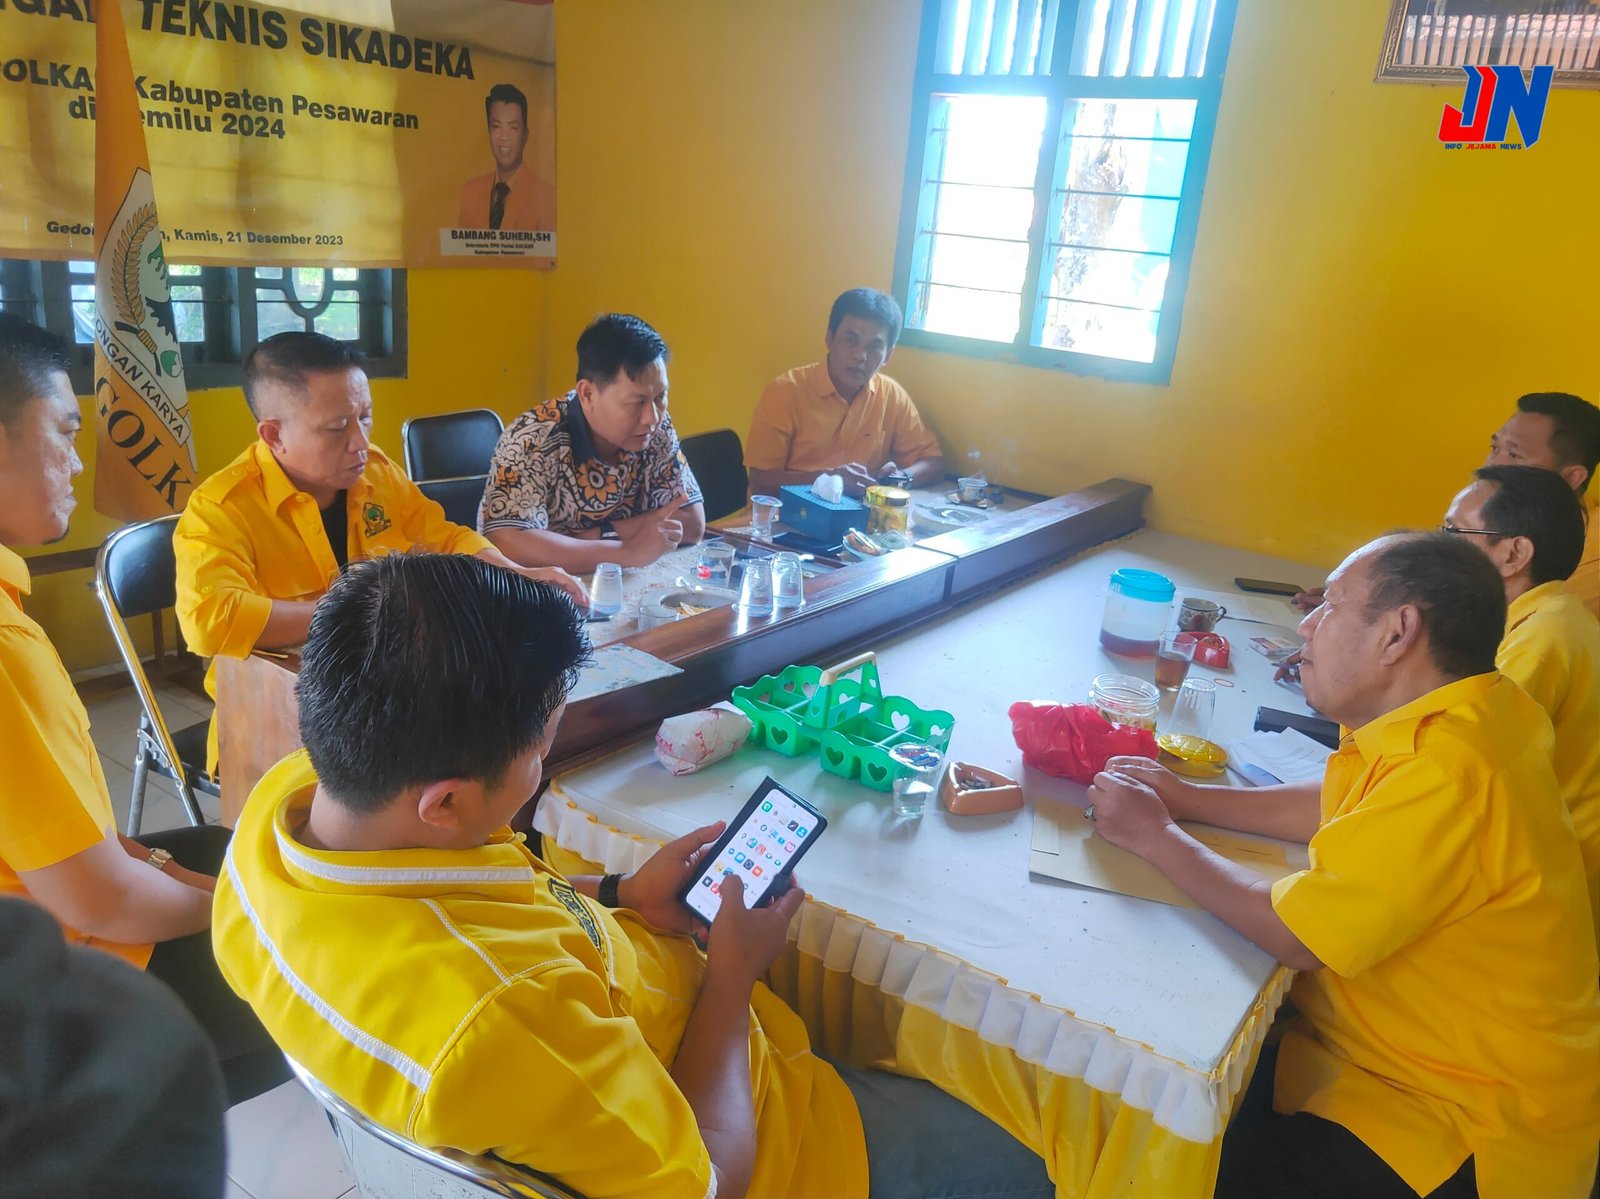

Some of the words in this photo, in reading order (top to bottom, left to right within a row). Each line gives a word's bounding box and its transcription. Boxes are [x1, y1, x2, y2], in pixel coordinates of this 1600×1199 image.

[139, 0, 288, 50] TEKNIS
[300, 18, 475, 80] SIKADEKA
[0, 58, 96, 92] OLKA
[134, 75, 283, 114] Kabupaten
[292, 94, 419, 130] Pesawaran
[140, 107, 212, 133] milu
[221, 112, 286, 139] 2024
[46, 221, 95, 236] Gedo
[174, 229, 223, 244] Kamis,
[226, 231, 242, 243] 21
[247, 231, 311, 246] Desember
[315, 235, 343, 246] 2023
[451, 230, 496, 240] BAMBANG
[94, 318, 144, 382] ONGAN
[141, 380, 185, 439] KARYA
[95, 376, 193, 510] GOLK
